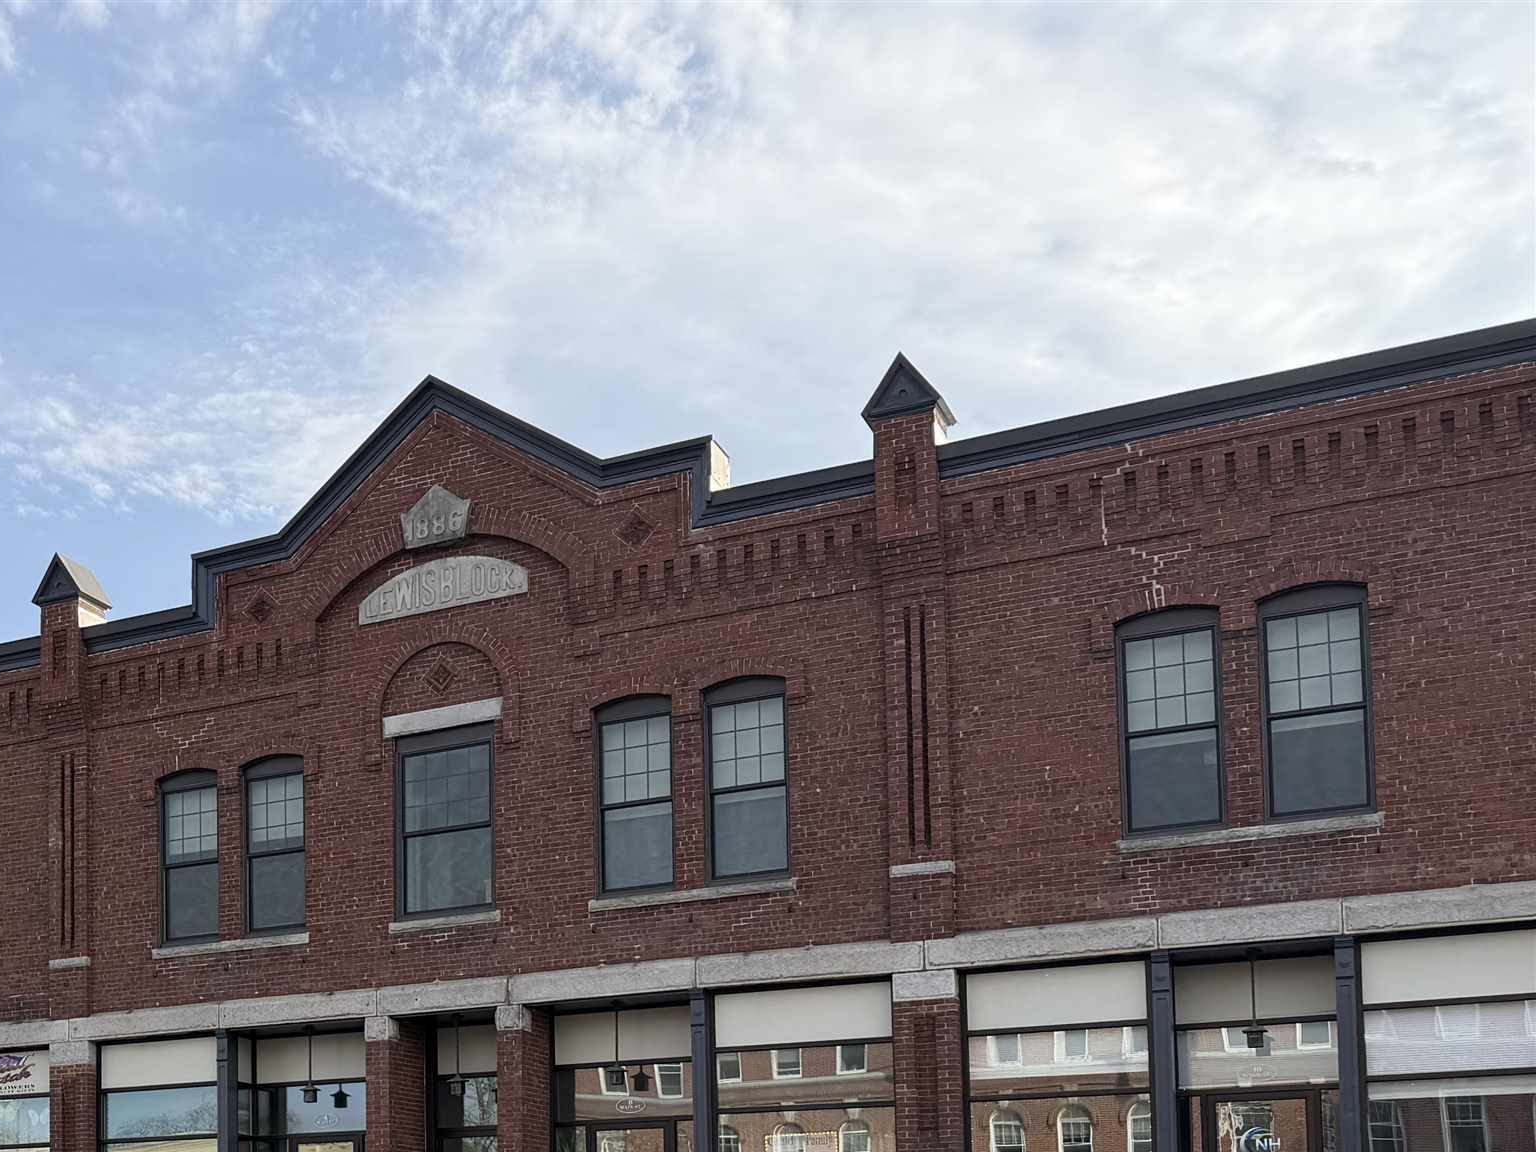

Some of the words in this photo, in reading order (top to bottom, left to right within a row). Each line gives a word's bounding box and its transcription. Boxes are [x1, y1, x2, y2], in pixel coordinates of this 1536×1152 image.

[407, 511, 464, 542] 1886
[365, 569, 436, 619] LEWIS
[1255, 1137, 1281, 1151] NH
